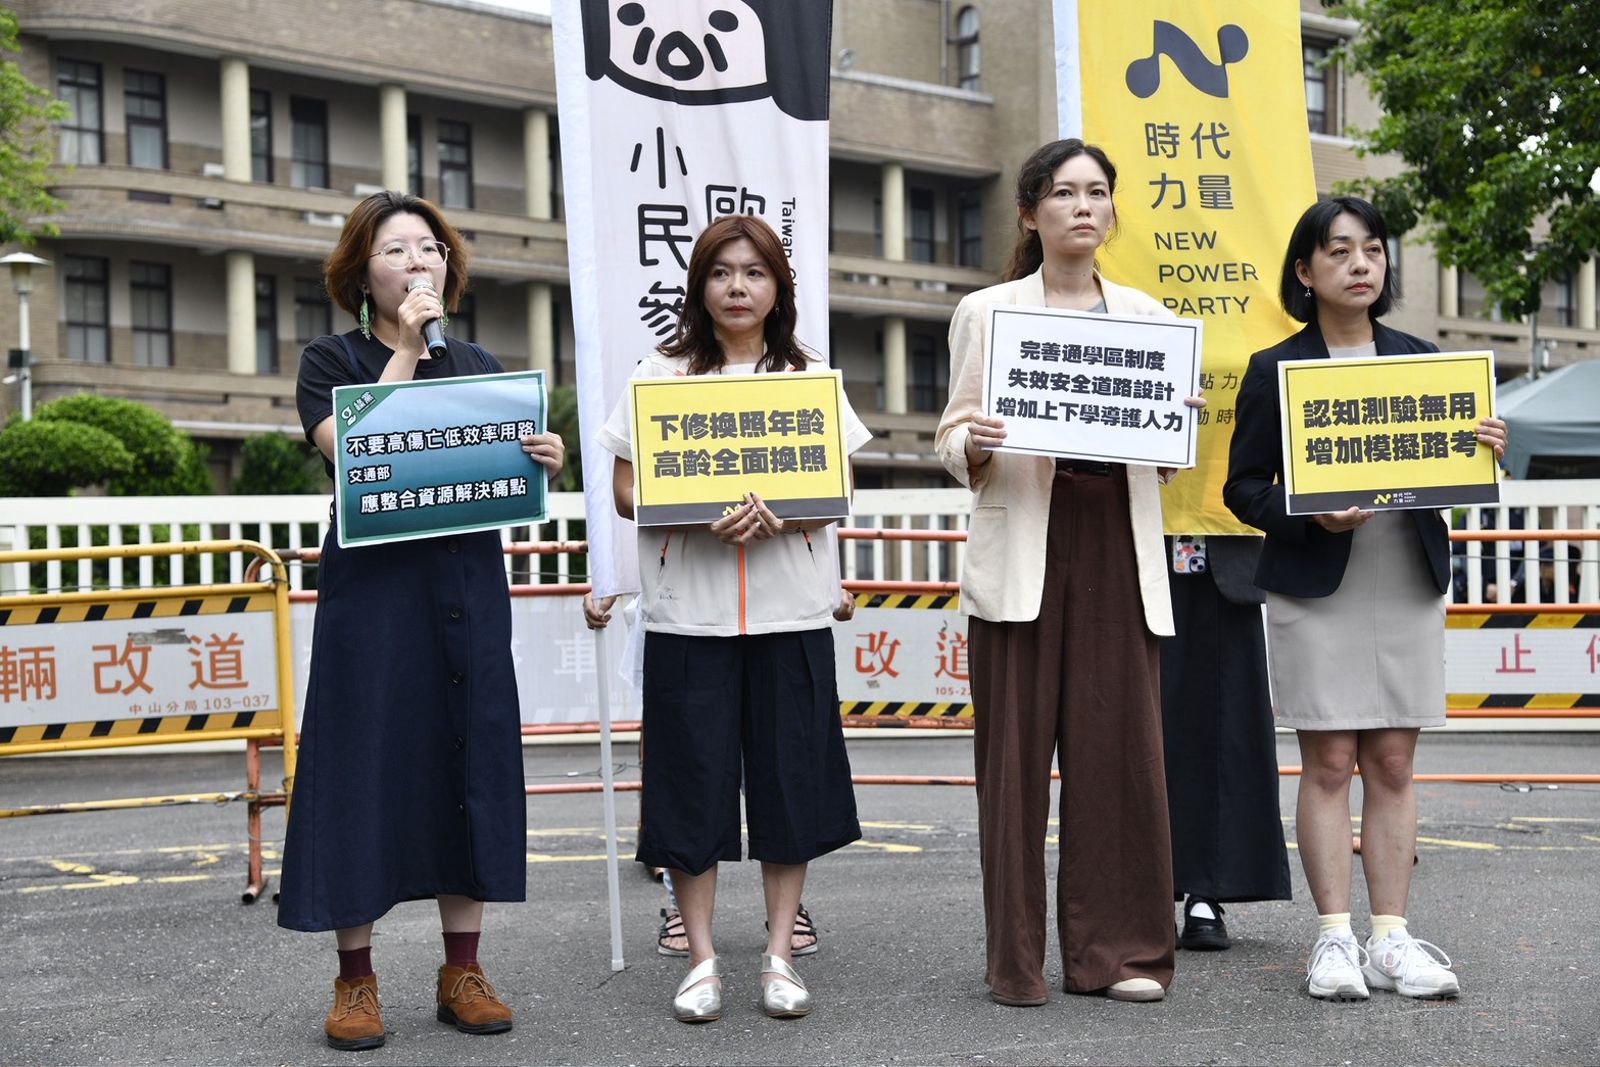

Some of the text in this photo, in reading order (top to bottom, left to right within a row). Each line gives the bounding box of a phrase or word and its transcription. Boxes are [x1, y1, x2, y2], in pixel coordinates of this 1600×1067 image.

[1144, 121, 1232, 160] 時代
[1148, 172, 1234, 211] 力量
[781, 197, 796, 259] Taiwan
[1154, 230, 1217, 251] NEW
[1158, 262, 1259, 284] POWER
[1163, 295, 1251, 316] PARTY
[1019, 340, 1166, 372] 完善通學區制度
[1007, 367, 1176, 402] 失效安全道路設計
[650, 407, 825, 442] 下修換照年齡
[995, 396, 1184, 433] 增加上下學導護人力
[1302, 391, 1477, 429] 認知測驗無用
[652, 444, 828, 479] 高齡全面換照
[1305, 429, 1479, 466] 增加模擬路考
[348, 465, 392, 485] 交通部
[360, 477, 528, 515] 應整合資源解決痛點
[129, 694, 270, 716] 中山分局 103-037
